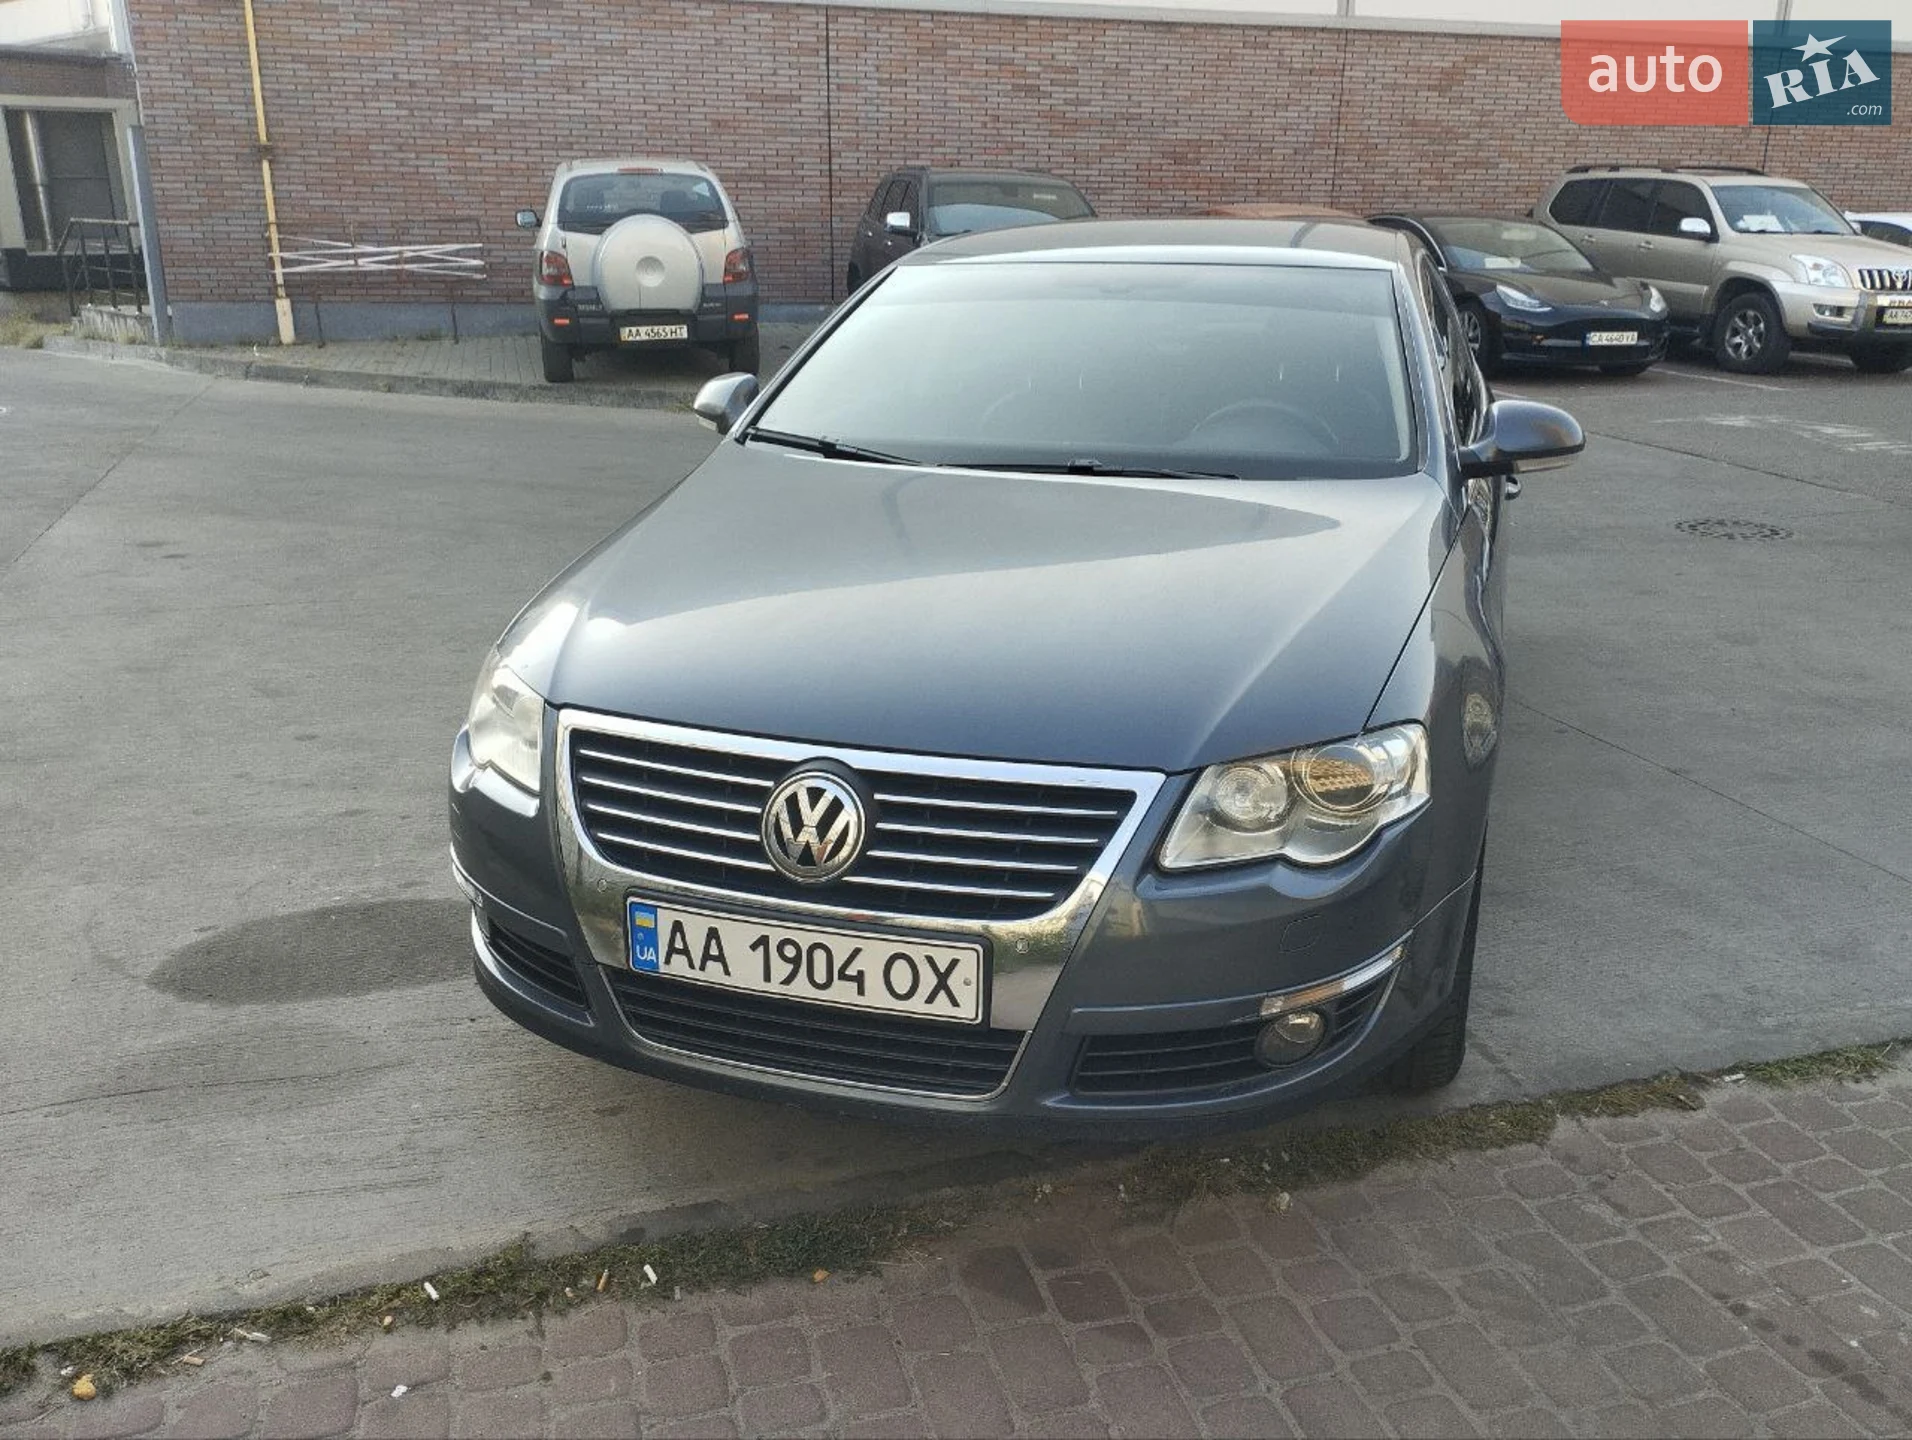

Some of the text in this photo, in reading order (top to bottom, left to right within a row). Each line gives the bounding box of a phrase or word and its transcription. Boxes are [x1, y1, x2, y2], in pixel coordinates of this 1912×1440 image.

[627, 328, 642, 339] AA
[670, 326, 685, 337] HT
[636, 944, 658, 963] UA
[663, 919, 961, 1009] AA 1904 OX
